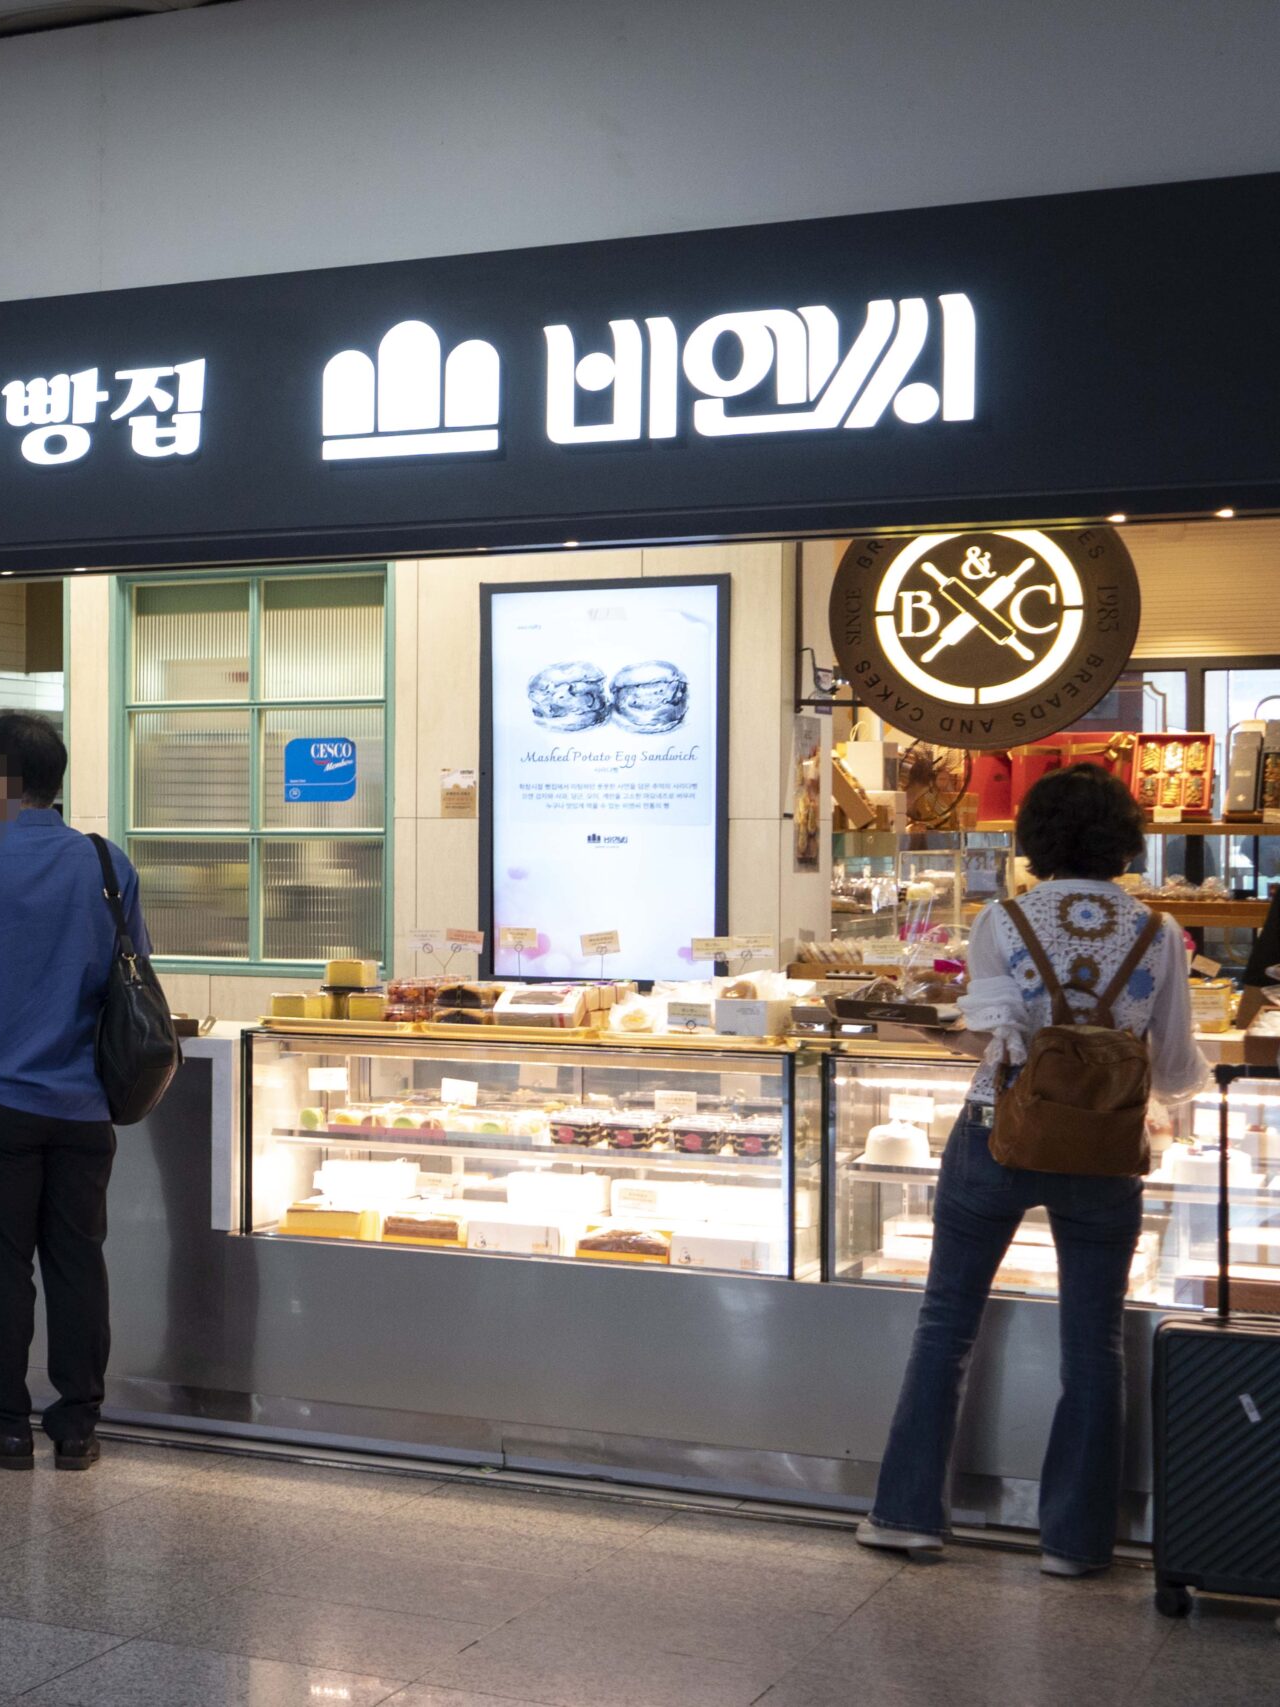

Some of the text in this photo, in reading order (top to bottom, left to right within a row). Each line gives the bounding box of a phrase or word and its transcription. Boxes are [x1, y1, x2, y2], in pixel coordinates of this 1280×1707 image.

[542, 293, 976, 444] 비앤씨
[846, 584, 1120, 647] SINCE 1983
[898, 546, 1058, 638] B & C
[855, 652, 1106, 735] BREADS AND CAKES
[310, 743, 352, 759] CESCO
[520, 745, 700, 769] Mashed Potato Egg Sandwich
